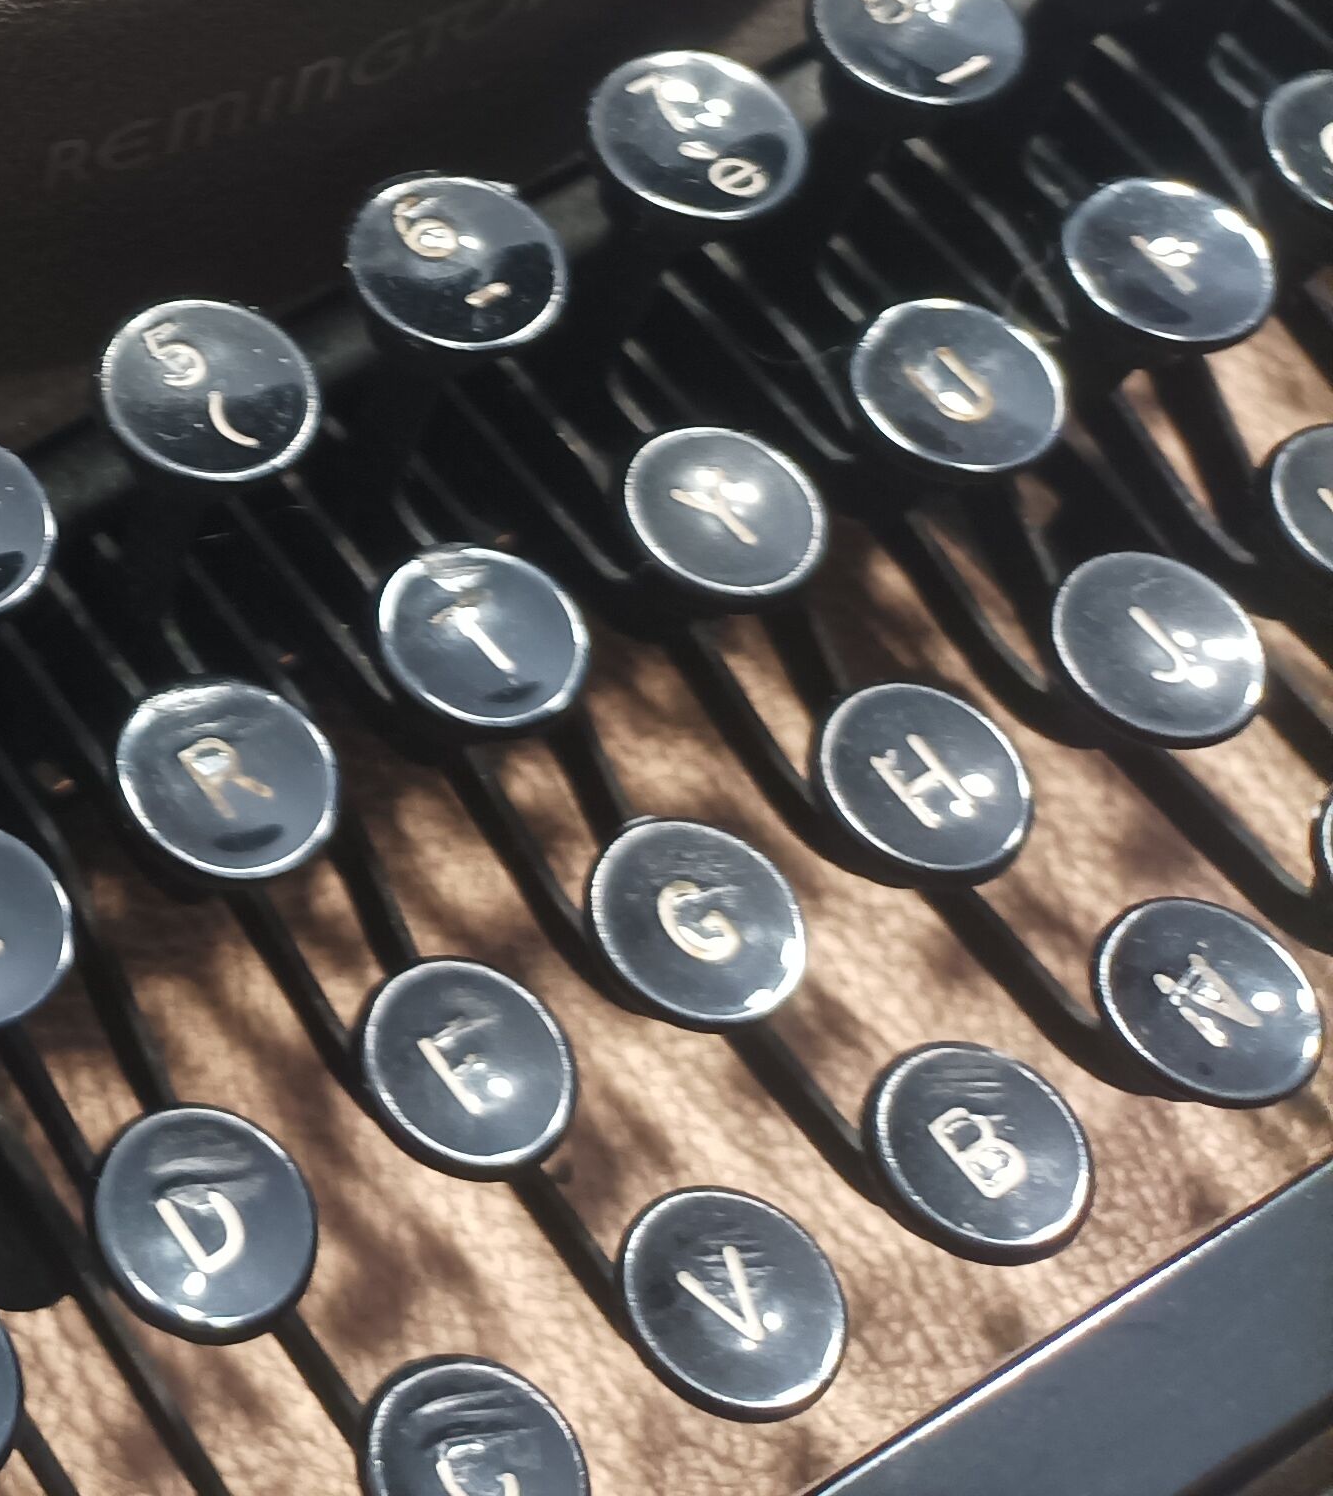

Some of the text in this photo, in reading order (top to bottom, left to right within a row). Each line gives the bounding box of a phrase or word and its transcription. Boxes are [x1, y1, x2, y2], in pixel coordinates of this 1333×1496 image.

[392, 195, 459, 259] 6
[141, 321, 207, 388] 5
[904, 346, 995, 423] U
[669, 466, 759, 547] Y
[428, 588, 518, 674] T
[1129, 605, 1196, 683] J
[177, 736, 275, 820] R
[869, 733, 975, 829] H
[656, 879, 740, 963] G
[1152, 953, 1264, 1048] N
[928, 1106, 1027, 1200] B
[154, 1188, 246, 1276] D
[676, 1244, 766, 1342] V
